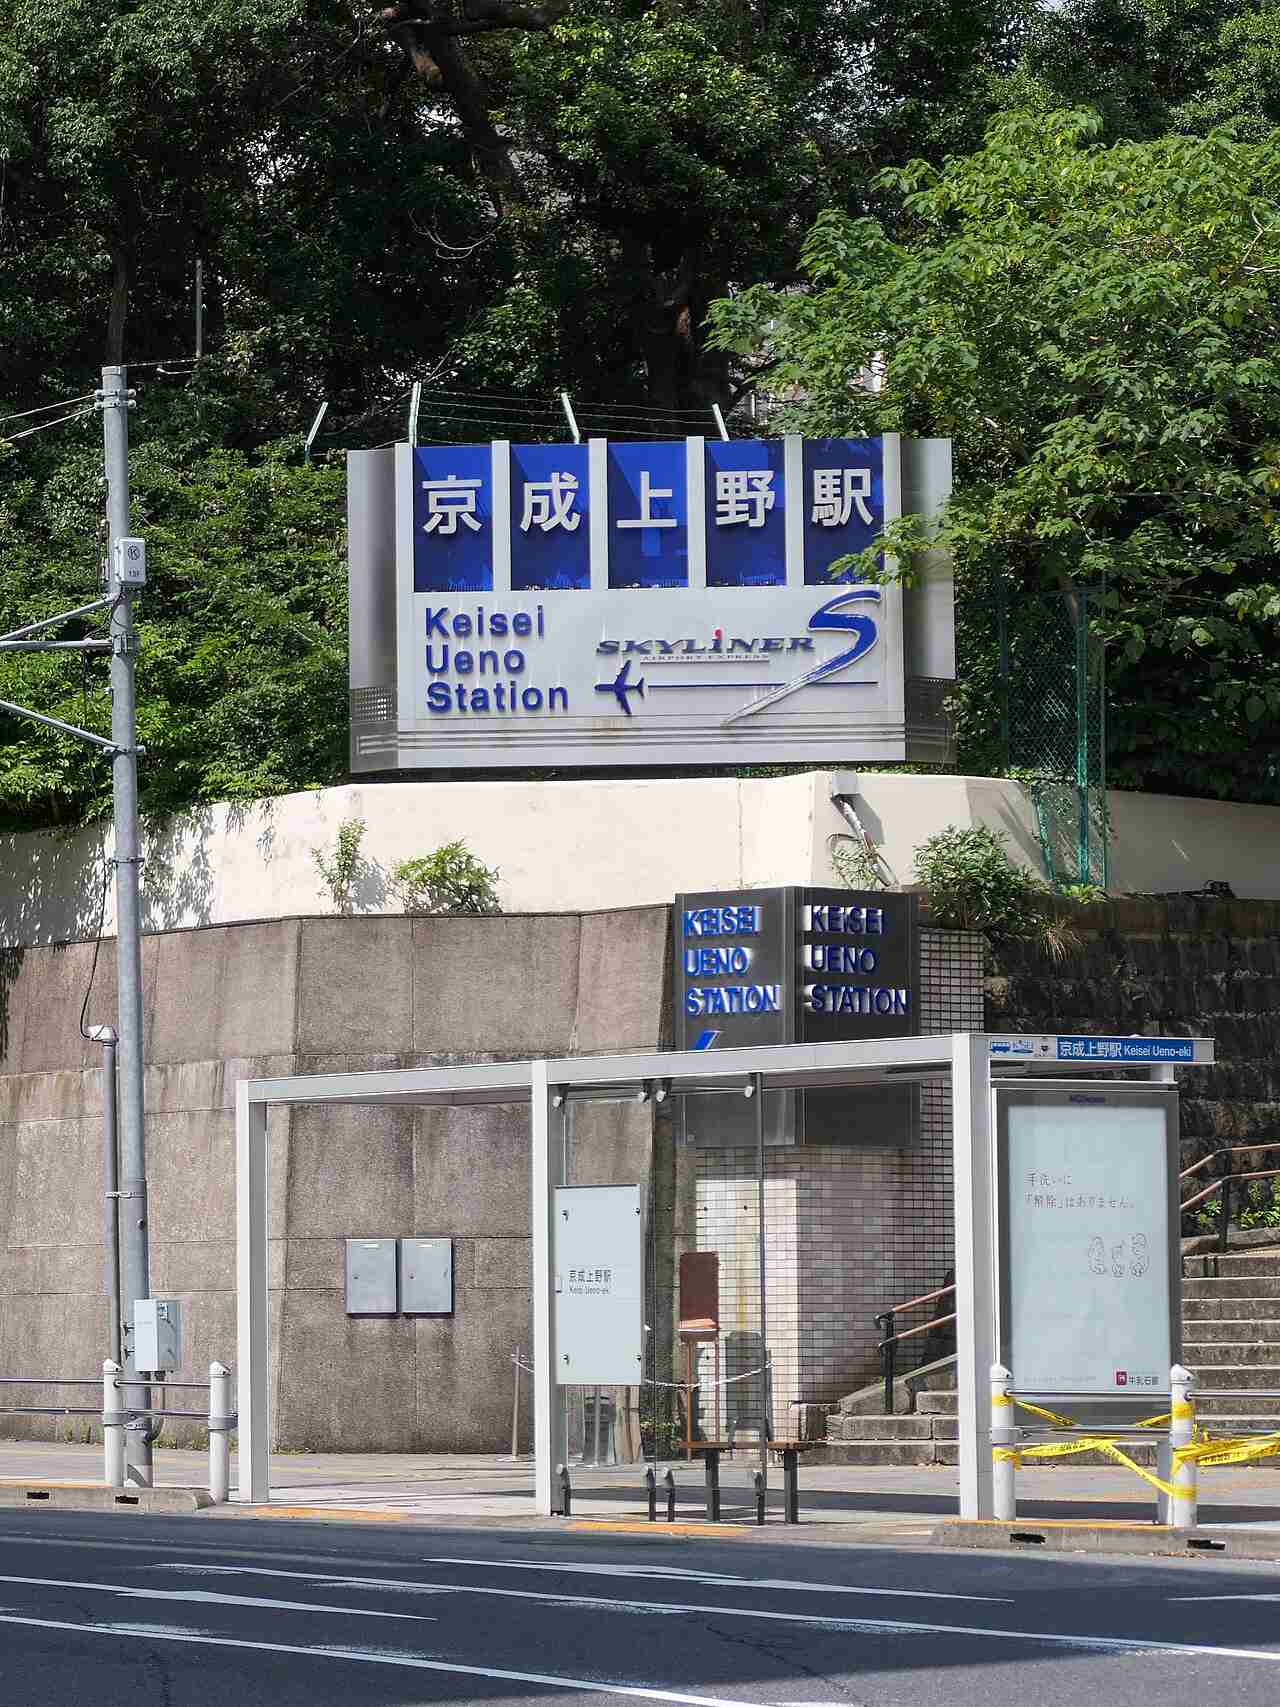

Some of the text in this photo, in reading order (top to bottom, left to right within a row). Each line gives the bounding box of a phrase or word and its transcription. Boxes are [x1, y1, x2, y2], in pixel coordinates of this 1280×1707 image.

[421, 467, 873, 536] 京成上野駅
[425, 604, 545, 639] Keisei
[426, 645, 526, 676] Ueno
[426, 681, 569, 714] Station
[683, 905, 761, 936] KEISEI
[805, 905, 884, 935] KEISEI
[684, 946, 750, 976] UENO
[805, 944, 877, 973] UENO
[686, 985, 782, 1016] STATION
[806, 984, 912, 1015] STATION
[1059, 1041, 1192, 1058] 京成上野駅 Keisei Ueno-eki
[569, 1269, 612, 1283] 京成上野駅
